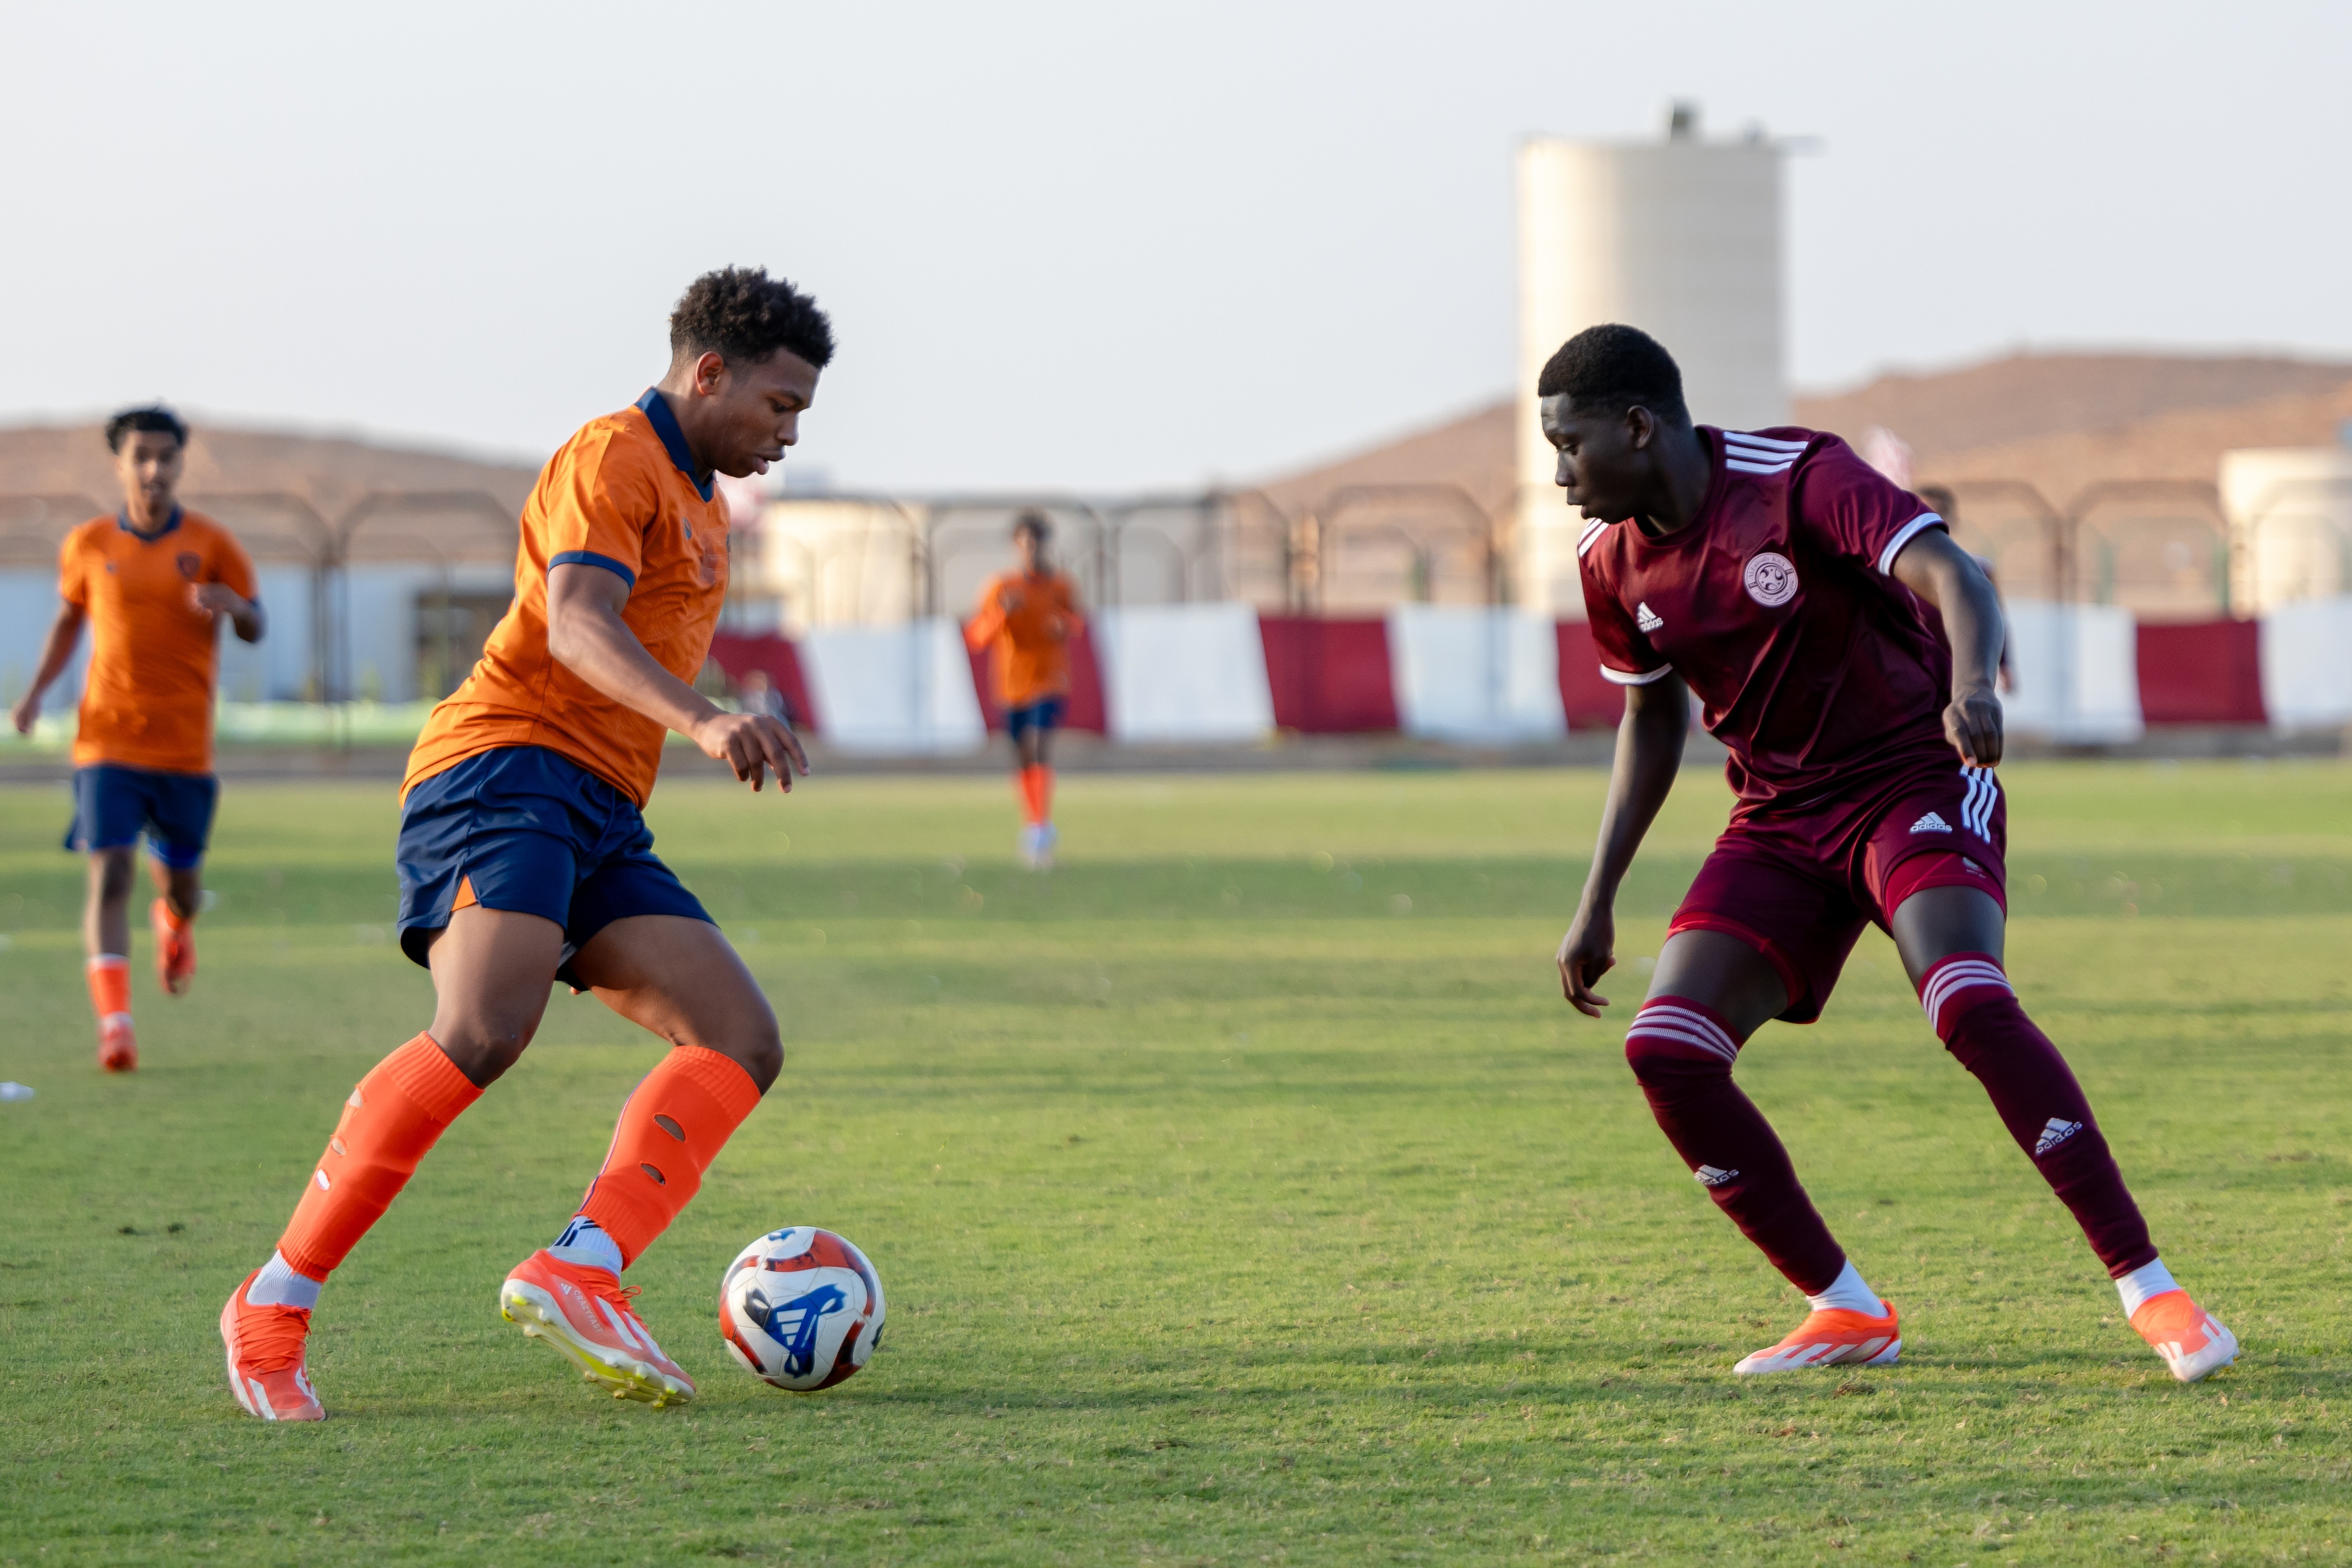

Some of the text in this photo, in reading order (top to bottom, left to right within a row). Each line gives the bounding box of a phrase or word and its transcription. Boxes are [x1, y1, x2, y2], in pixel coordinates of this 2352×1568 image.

[1638, 617, 1664, 633] adidas
[1910, 823, 1953, 834] adidas
[2036, 1121, 2083, 1154] adidas
[1701, 1169, 1740, 1185] idas
[573, 1289, 604, 1332] CRAZYFAST
